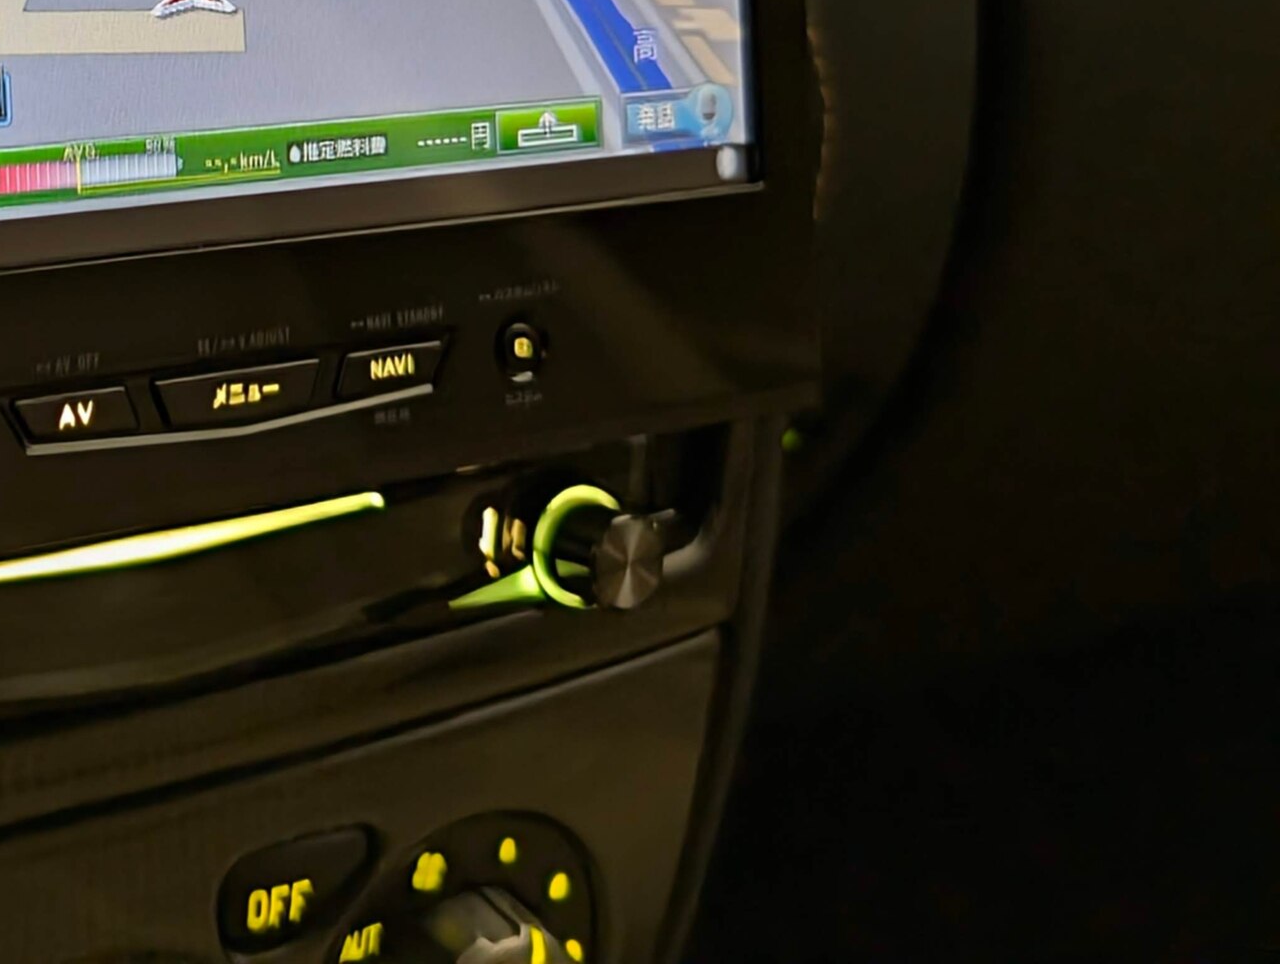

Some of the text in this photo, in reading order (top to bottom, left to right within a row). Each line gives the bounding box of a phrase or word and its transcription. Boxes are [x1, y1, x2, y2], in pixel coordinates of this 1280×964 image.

[370, 352, 415, 380] NAVI
[59, 399, 94, 431] AV
[246, 878, 315, 932] OFF
